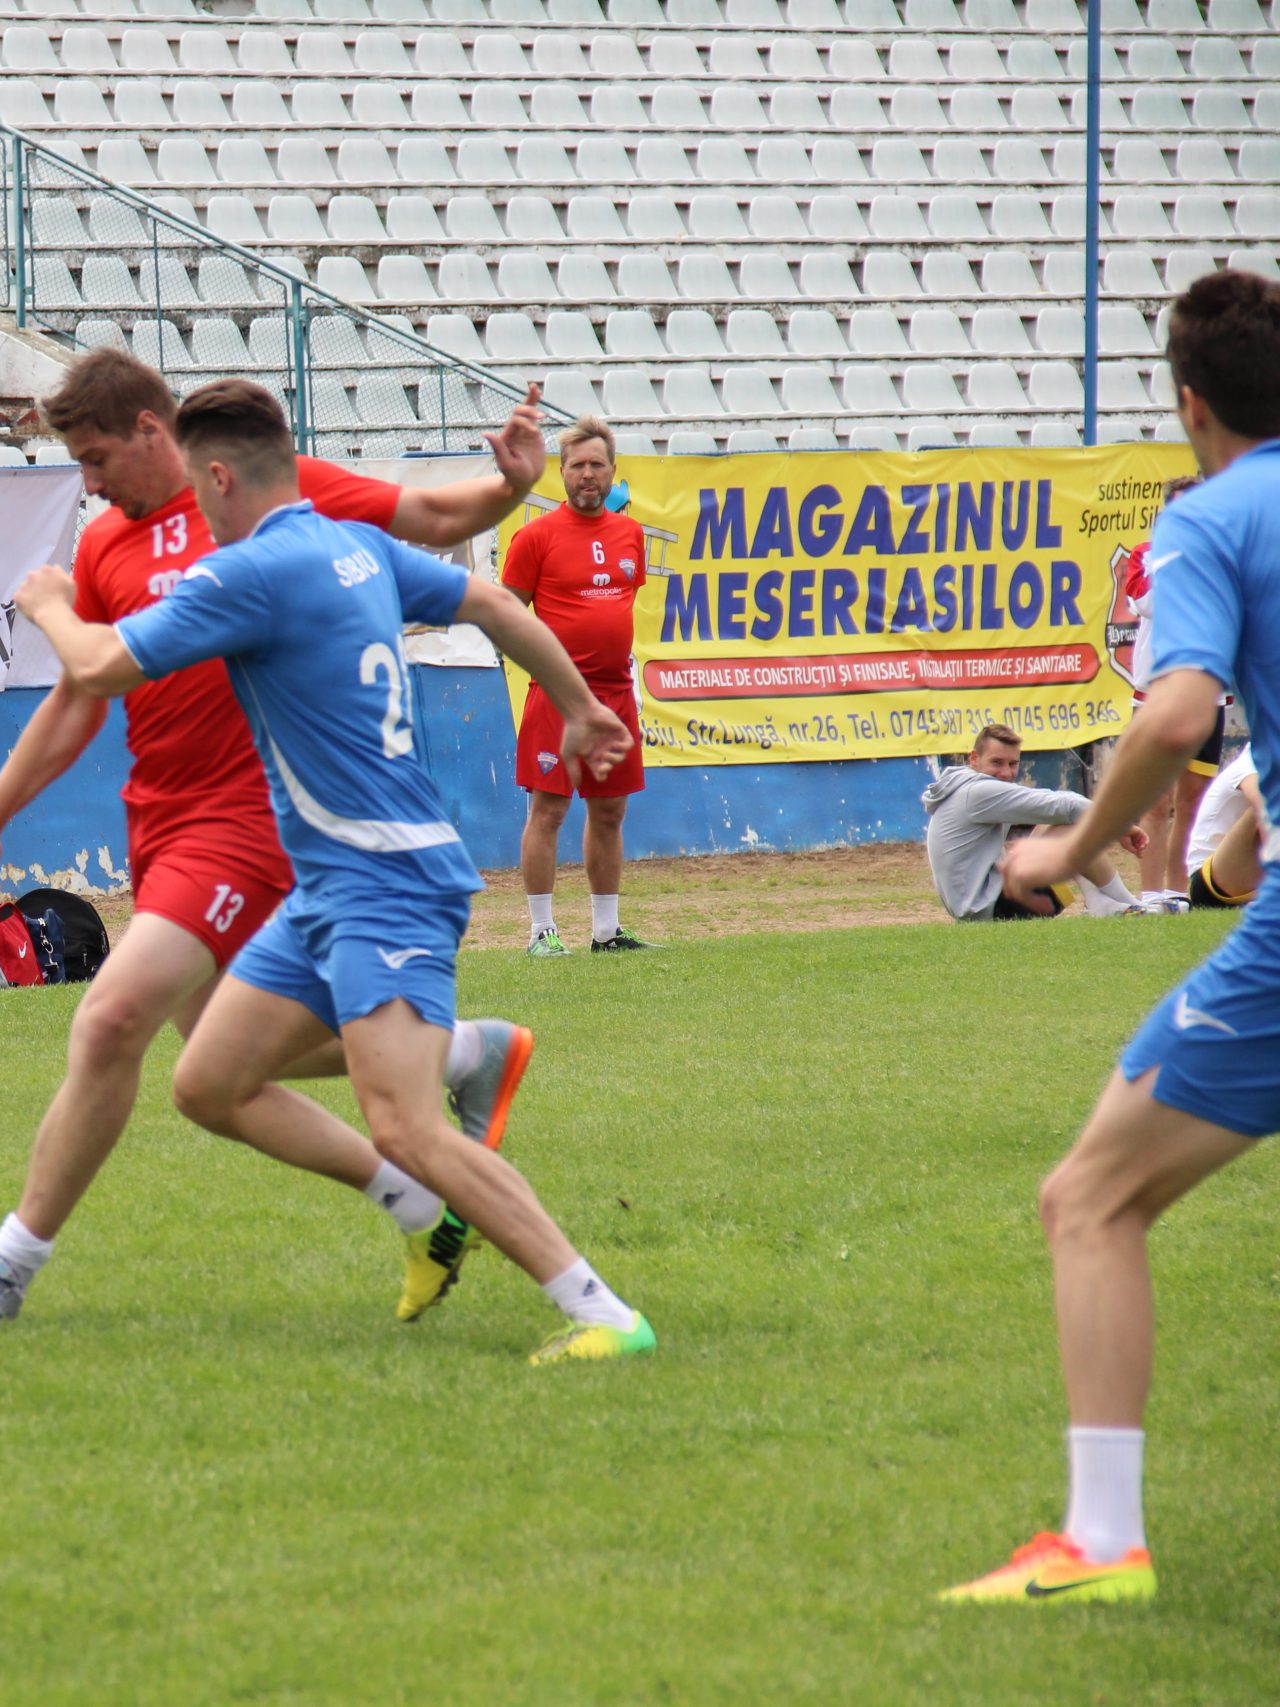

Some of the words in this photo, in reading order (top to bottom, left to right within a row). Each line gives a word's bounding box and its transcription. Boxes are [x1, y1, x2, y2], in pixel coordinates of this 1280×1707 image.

[152, 513, 188, 558] 13
[688, 478, 1063, 561] MAGAZINUL
[1078, 506, 1136, 539] Sportul
[332, 550, 381, 588] SIBIU
[591, 540, 606, 565] 6
[659, 559, 1086, 643] MESERIASILOR
[659, 668, 734, 689] MATERIALE
[734, 667, 751, 687] DE
[855, 660, 916, 683] FINISAJE,
[964, 657, 1013, 678] TERMICE
[1026, 654, 1082, 675] SANITARE
[788, 714, 847, 746] nr.26,
[847, 711, 886, 741] Tel.
[889, 708, 941, 738] 0745
[938, 708, 963, 735] 987
[1003, 704, 1044, 732] 0745
[1048, 702, 1081, 731] 696
[1085, 698, 1120, 727] 366
[204, 884, 246, 934] 13
